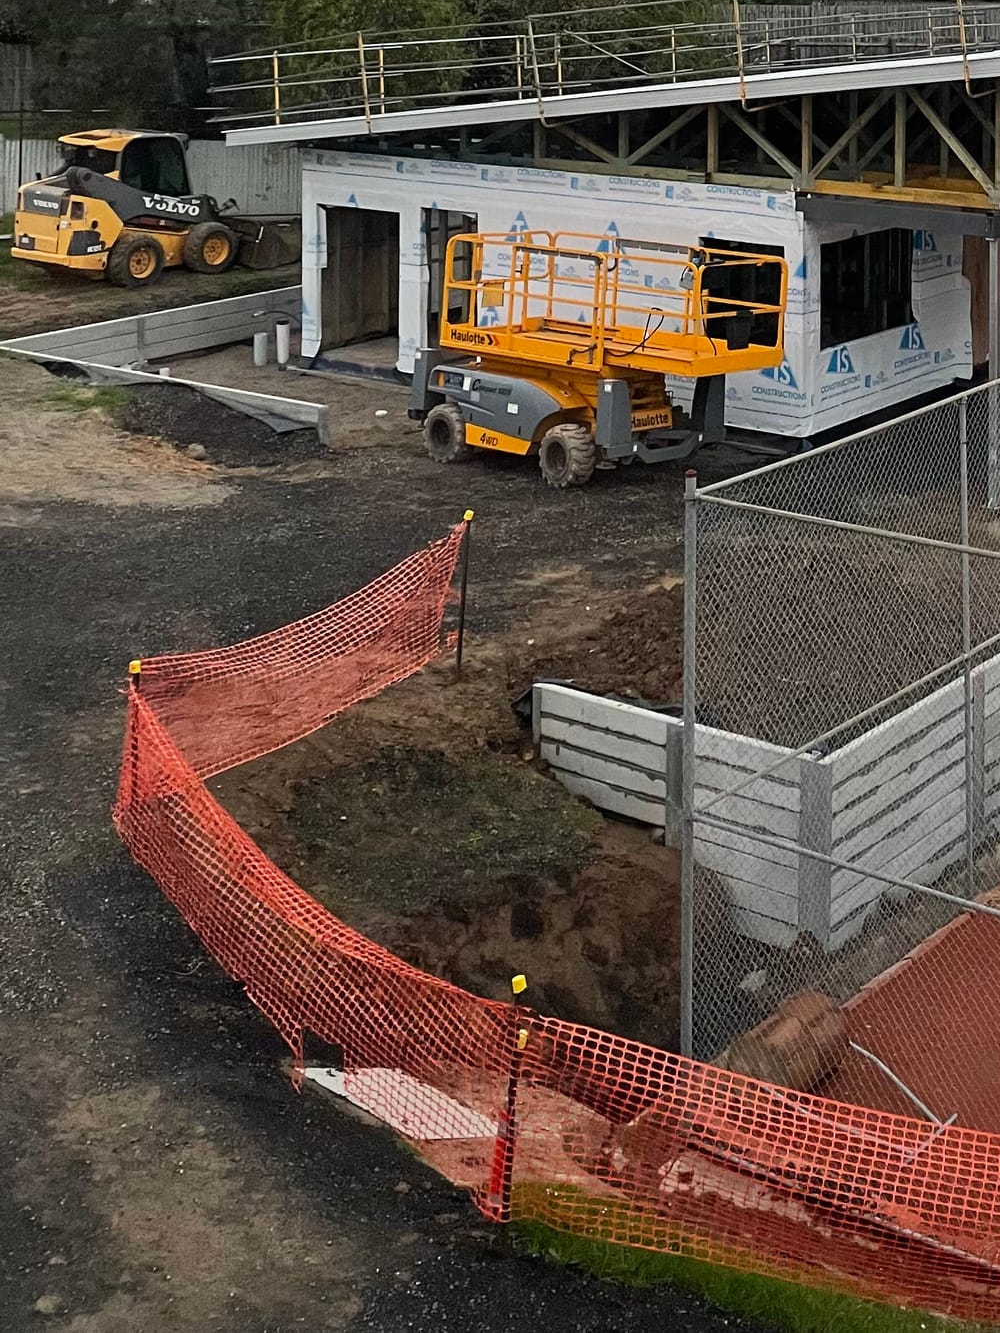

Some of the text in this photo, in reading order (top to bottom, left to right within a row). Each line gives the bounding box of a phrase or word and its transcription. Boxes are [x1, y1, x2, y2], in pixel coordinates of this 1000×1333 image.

[33, 199, 59, 209] VOLVO
[142, 196, 200, 216] VOLVO
[451, 329, 486, 345] Haulotte
[752, 386, 806, 401] CONSTRUCTIONS
[480, 432, 498, 447] 4WD
